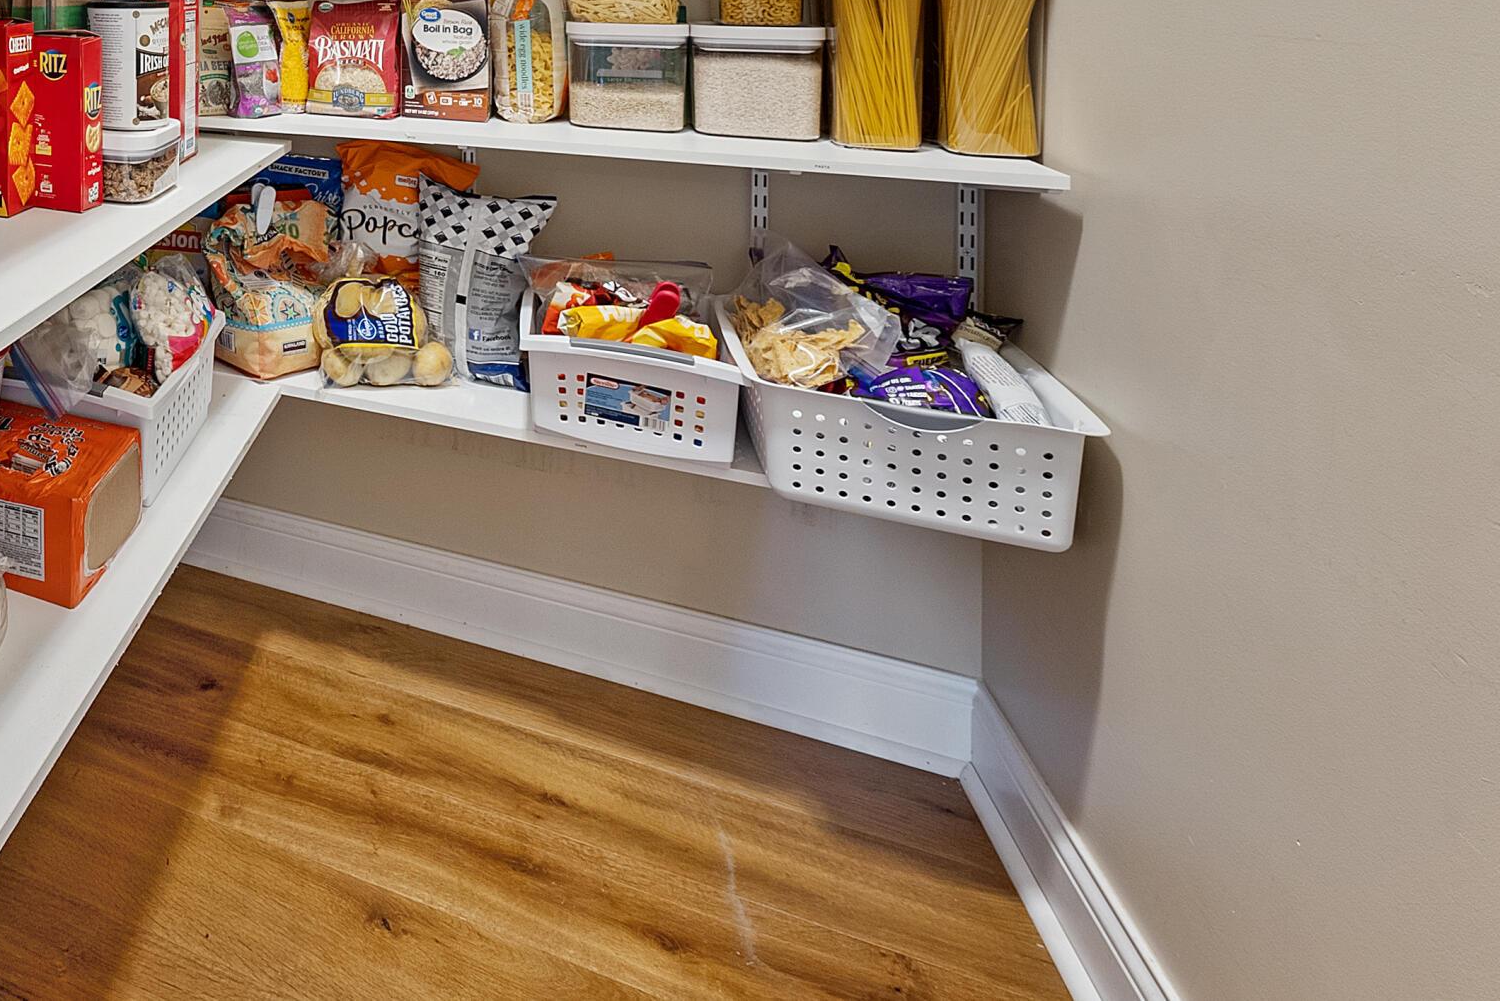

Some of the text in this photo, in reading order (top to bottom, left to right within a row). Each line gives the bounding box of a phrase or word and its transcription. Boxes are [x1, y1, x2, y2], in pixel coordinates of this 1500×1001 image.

[331, 25, 375, 35] CALIFORNIA
[423, 24, 473, 35] Boil in Bag
[519, 24, 529, 42] wide
[39, 51, 68, 74] RITZ
[140, 53, 161, 74] IRISH
[315, 35, 385, 71] BASMATI
[520, 58, 530, 89] noodles
[85, 85, 102, 112] RITZ
[270, 164, 328, 178] SNACK FACTORY
[386, 307, 400, 343] GOLD
[394, 283, 413, 345] POTATOES
